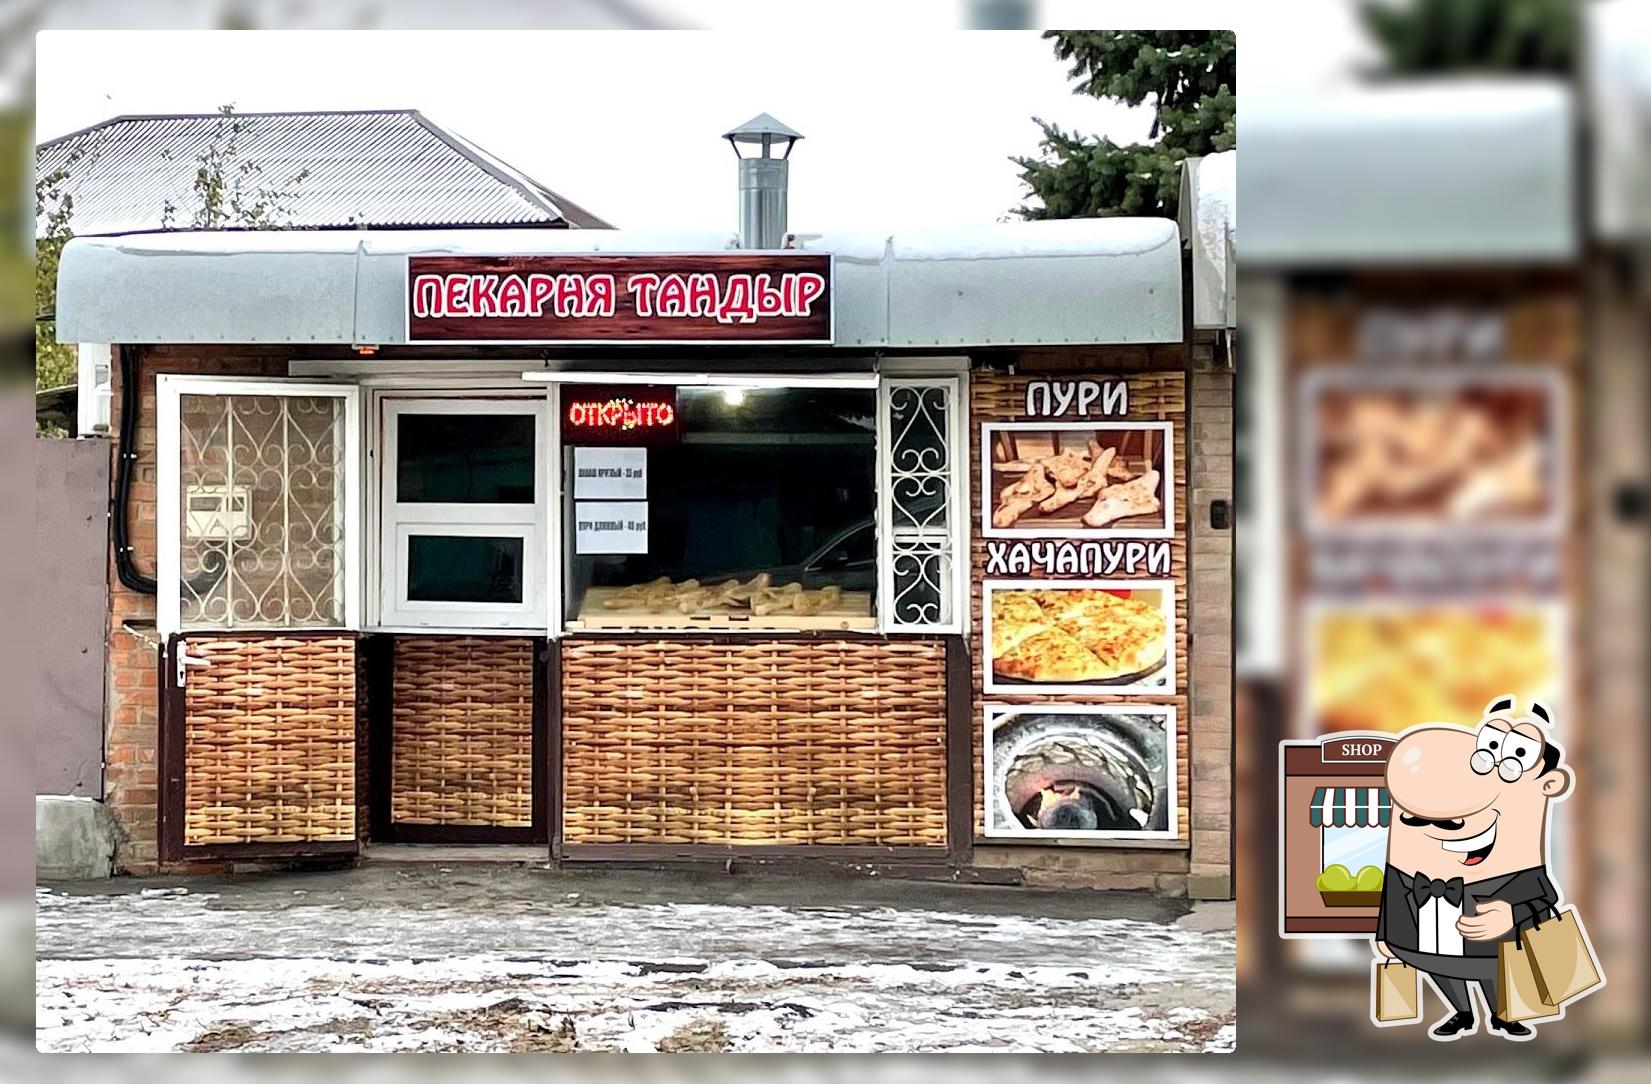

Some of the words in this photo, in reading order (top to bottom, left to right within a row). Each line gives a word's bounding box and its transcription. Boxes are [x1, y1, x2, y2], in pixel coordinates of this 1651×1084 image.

[414, 274, 616, 317] ПЕКАРНЯ
[628, 273, 825, 323] ТАНДЫР
[570, 399, 674, 428] ОТКРЫТО
[1026, 381, 1128, 416] ПУРИ
[986, 541, 1172, 575] ХАЧАПУРИ
